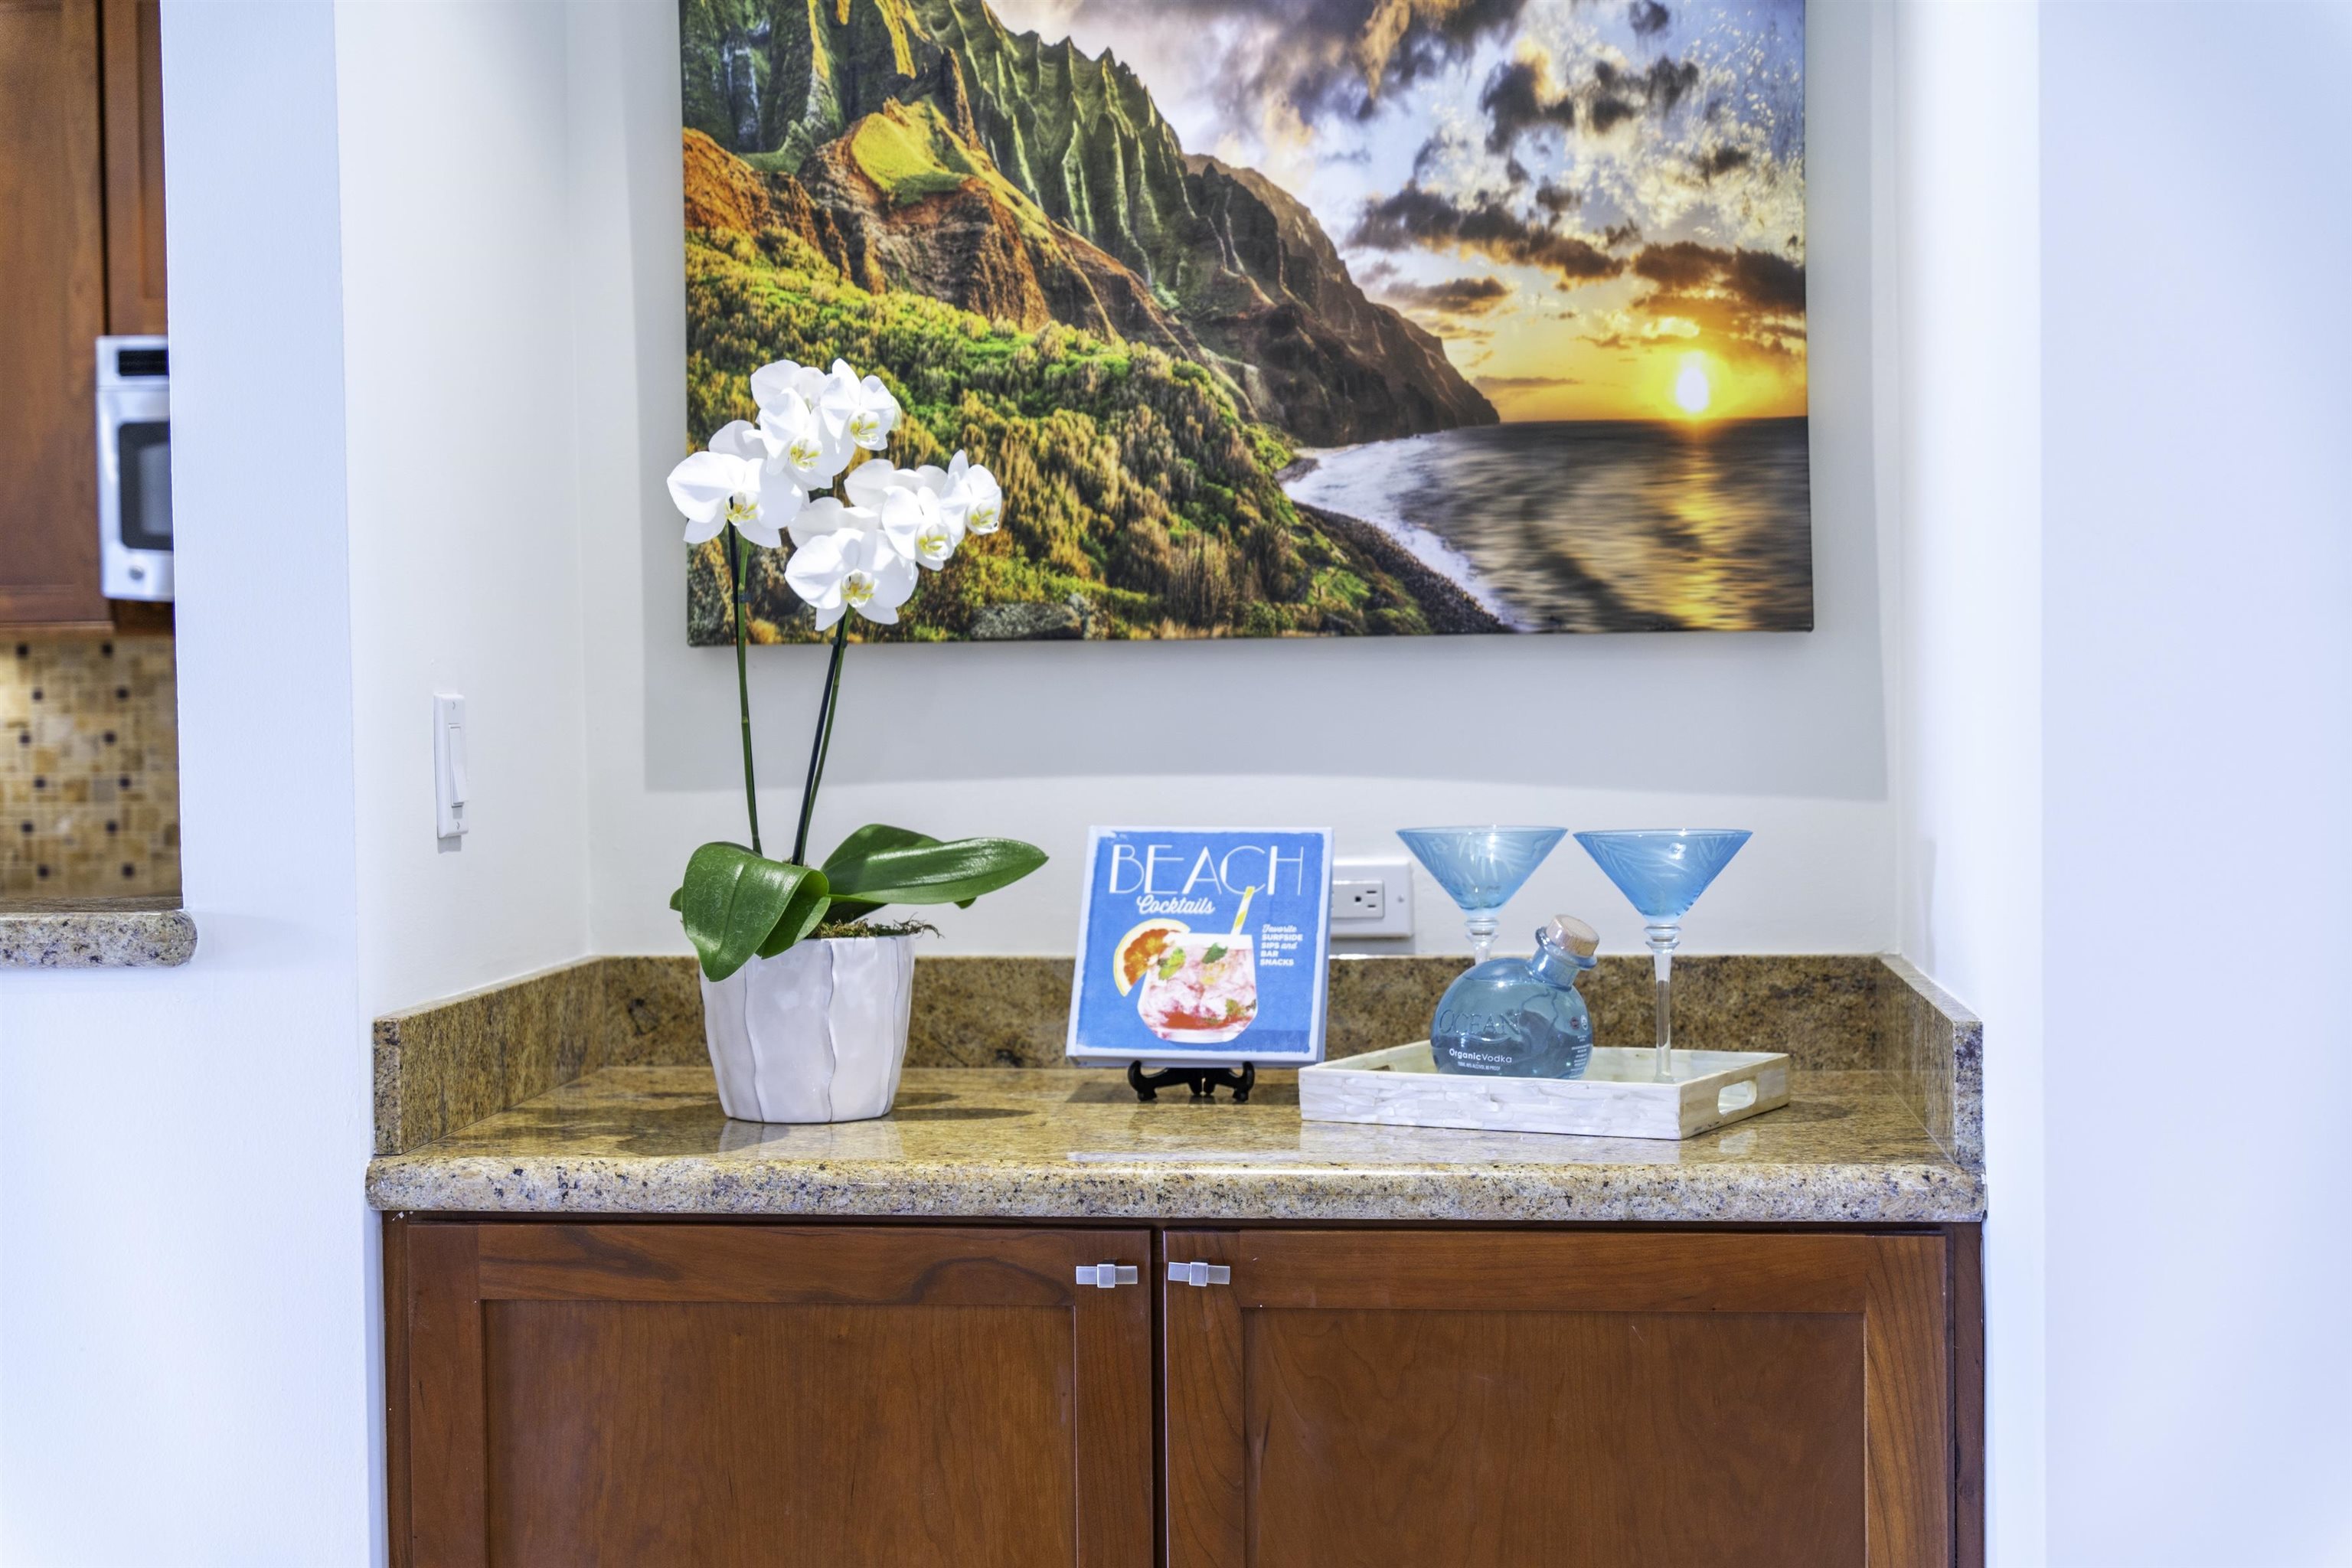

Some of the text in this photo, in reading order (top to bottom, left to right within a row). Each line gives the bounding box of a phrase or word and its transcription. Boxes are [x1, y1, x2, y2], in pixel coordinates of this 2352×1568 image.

[1109, 844, 1304, 896] BEACH
[1136, 894, 1216, 915] Cocktails
[1262, 923, 1298, 933] Favorite
[1281, 941, 1298, 949] and
[1260, 949, 1279, 958] BAR
[1259, 958, 1294, 966] SNACKS
[1439, 1009, 1521, 1035] OCEAN
